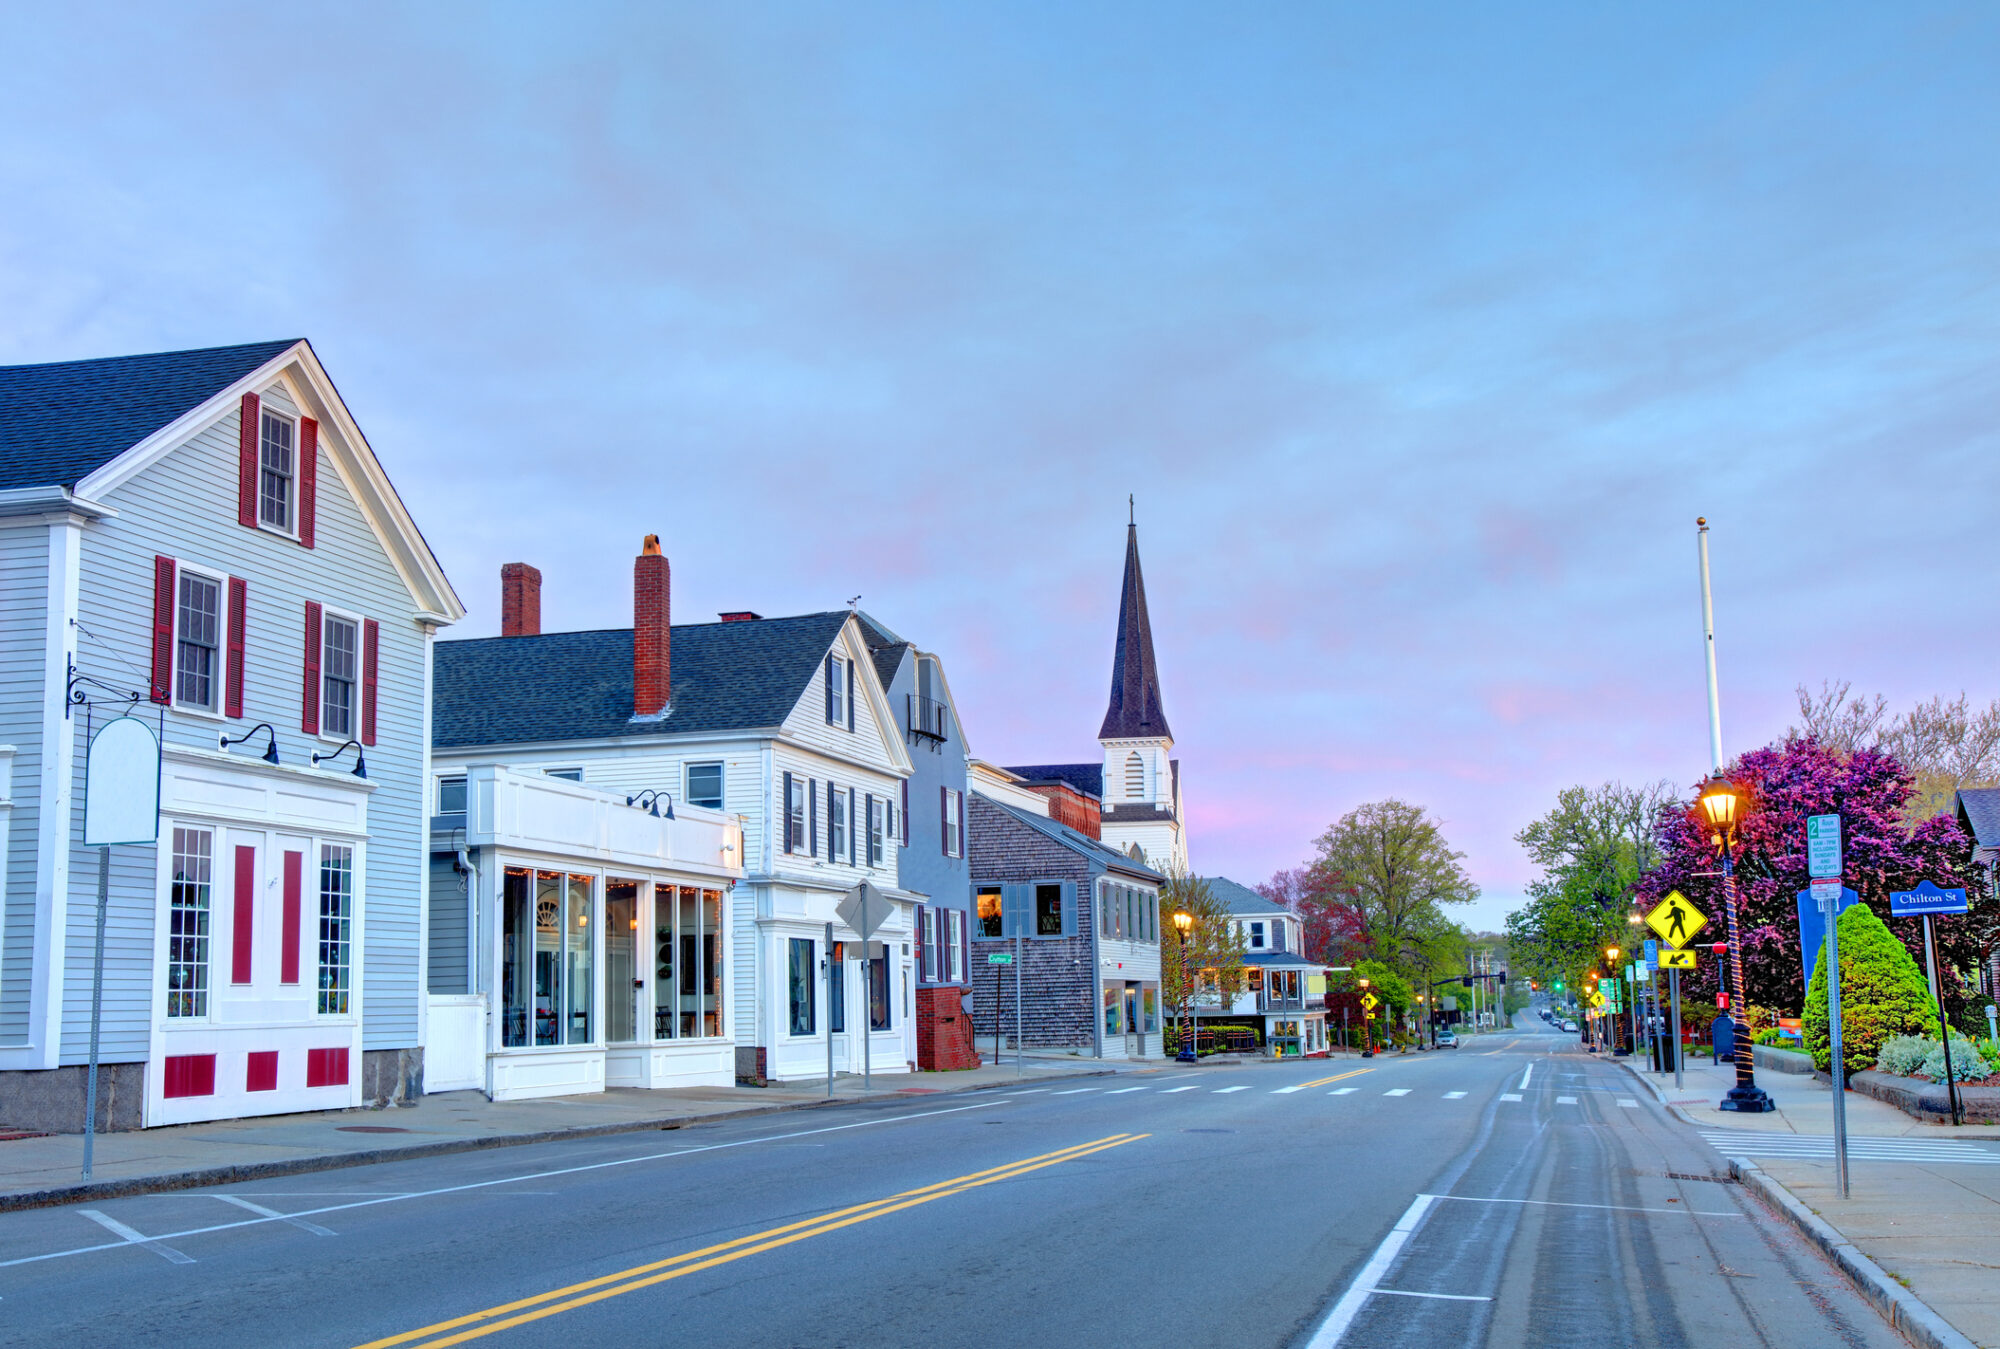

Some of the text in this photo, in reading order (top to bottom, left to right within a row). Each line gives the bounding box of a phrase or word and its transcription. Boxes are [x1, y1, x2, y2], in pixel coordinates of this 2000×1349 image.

[1810, 821, 1817, 836] 2
[1899, 892, 1957, 904] Chilton St
